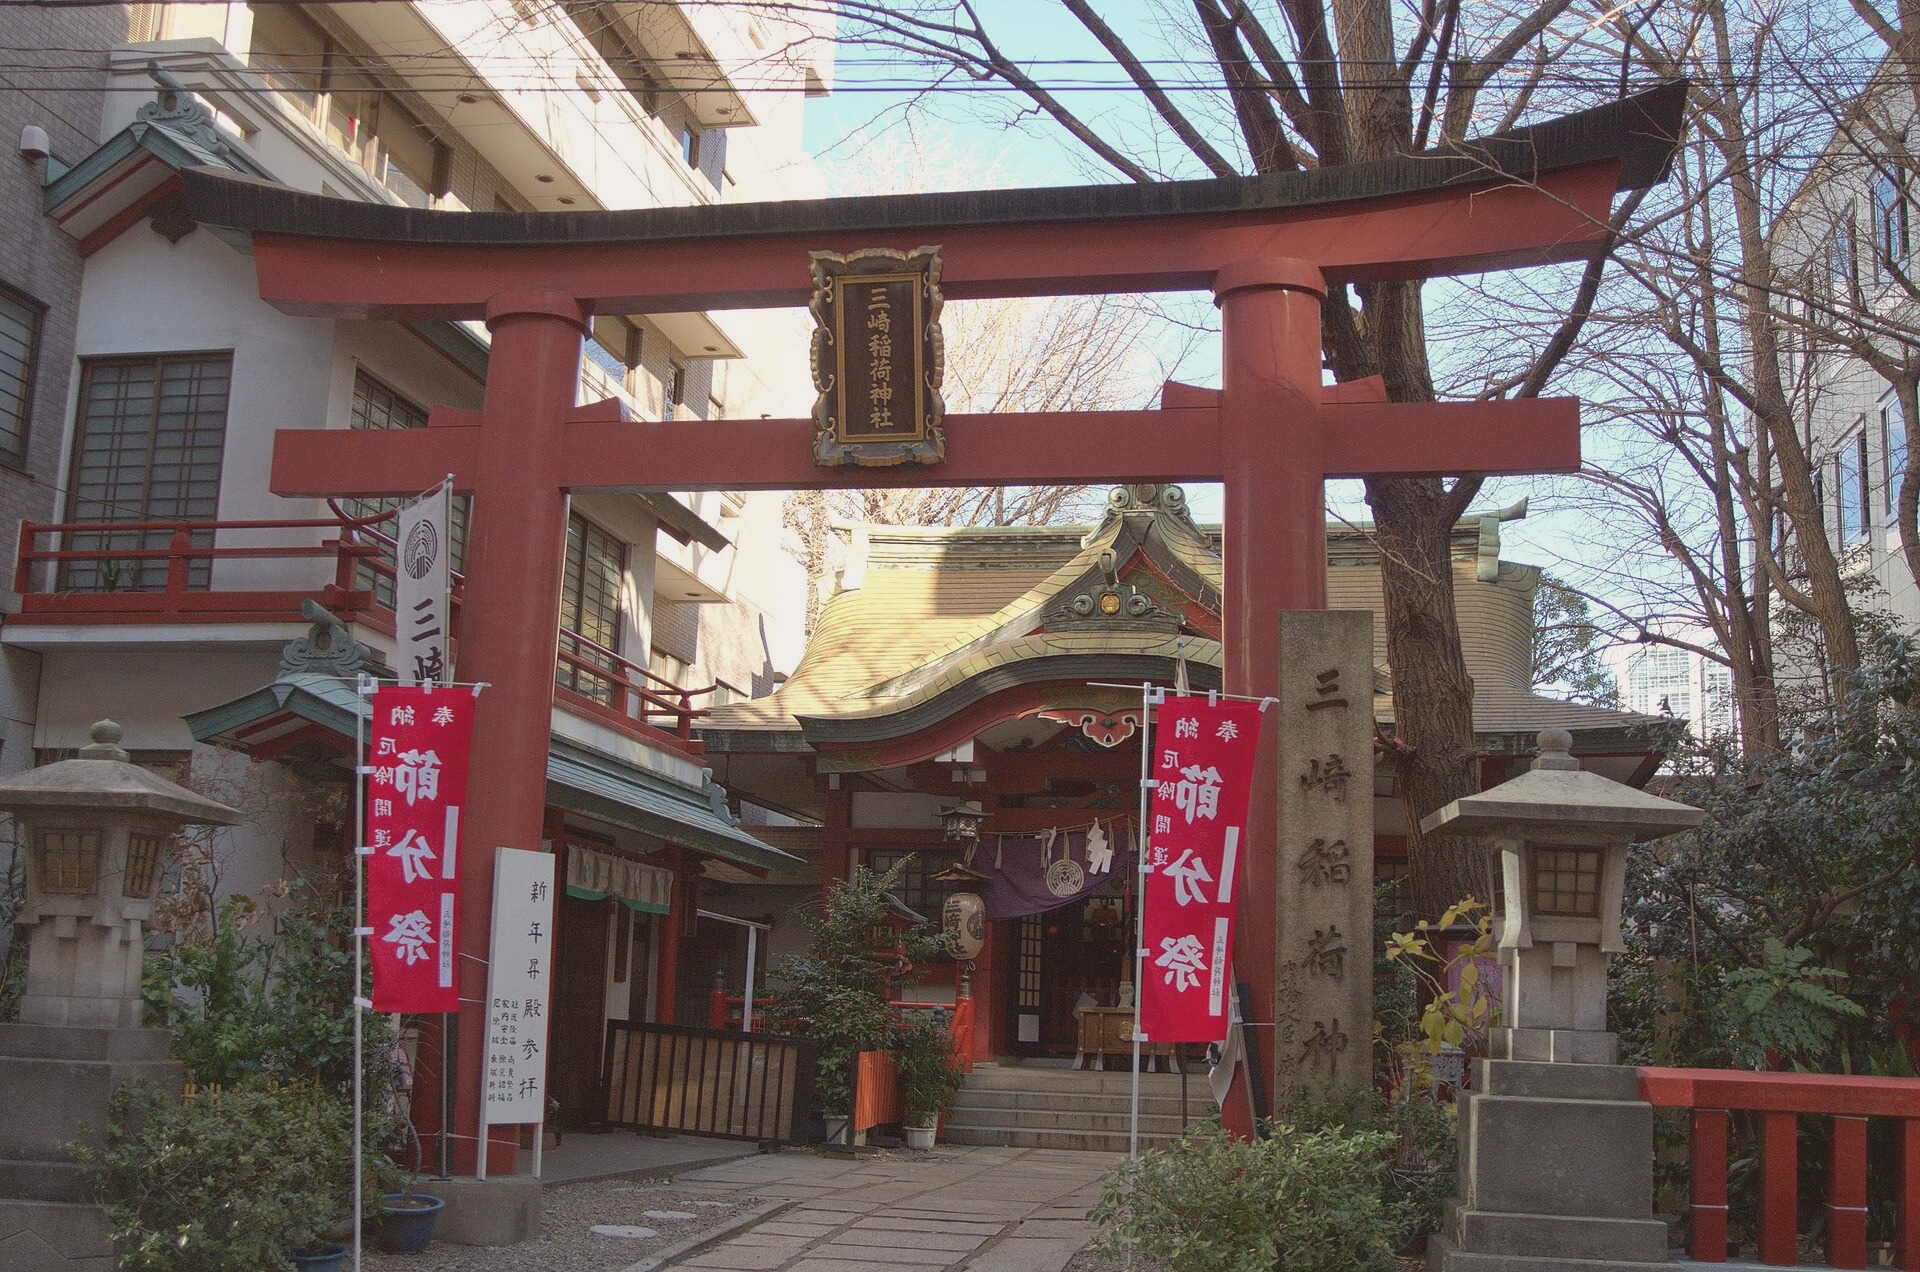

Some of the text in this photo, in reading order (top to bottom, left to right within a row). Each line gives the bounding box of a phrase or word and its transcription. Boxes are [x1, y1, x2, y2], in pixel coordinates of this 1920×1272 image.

[867, 288, 894, 429] 三崎稲荷神社
[519, 881, 547, 1099] 新年昇殿参拝
